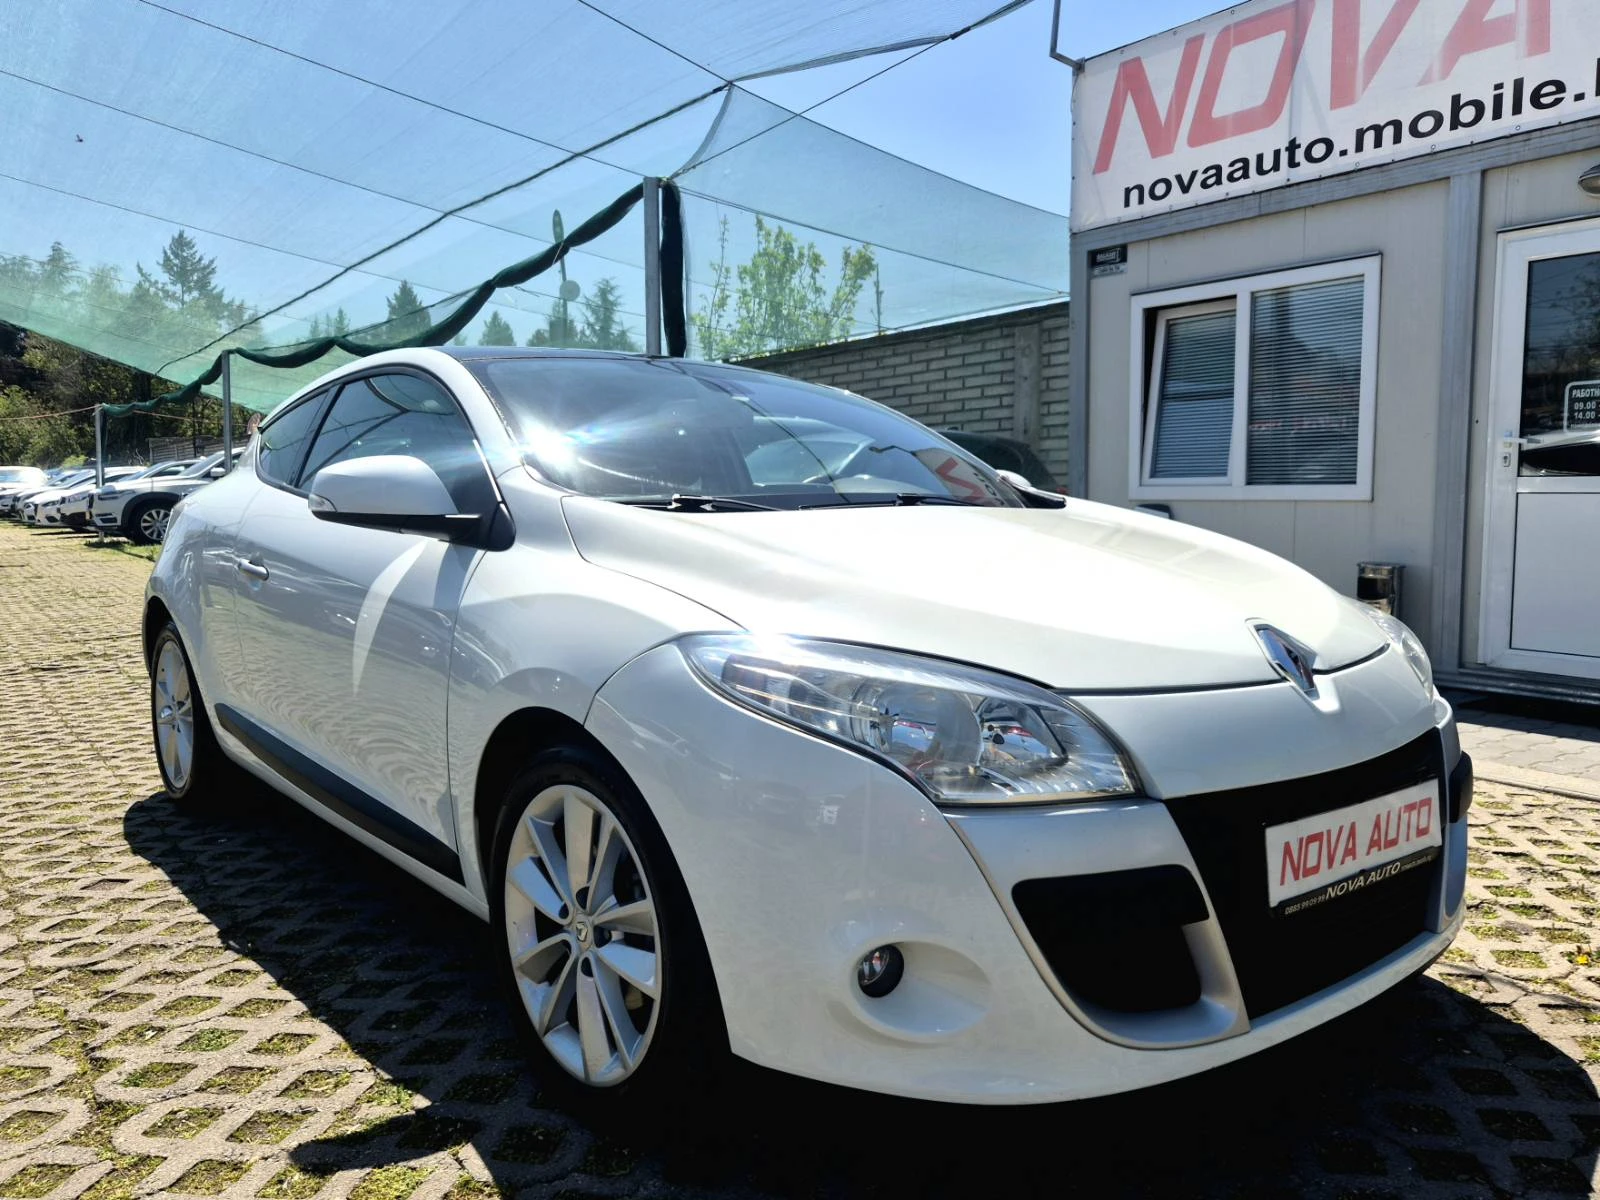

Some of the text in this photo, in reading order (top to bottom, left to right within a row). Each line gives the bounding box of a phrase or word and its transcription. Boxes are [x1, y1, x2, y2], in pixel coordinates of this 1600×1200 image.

[1123, 58, 1600, 208] novaauto.mobile.
[1280, 797, 1433, 885] NOVA AUTO
[1326, 876, 1365, 900] NOVA
[1366, 862, 1401, 885] AUTO
